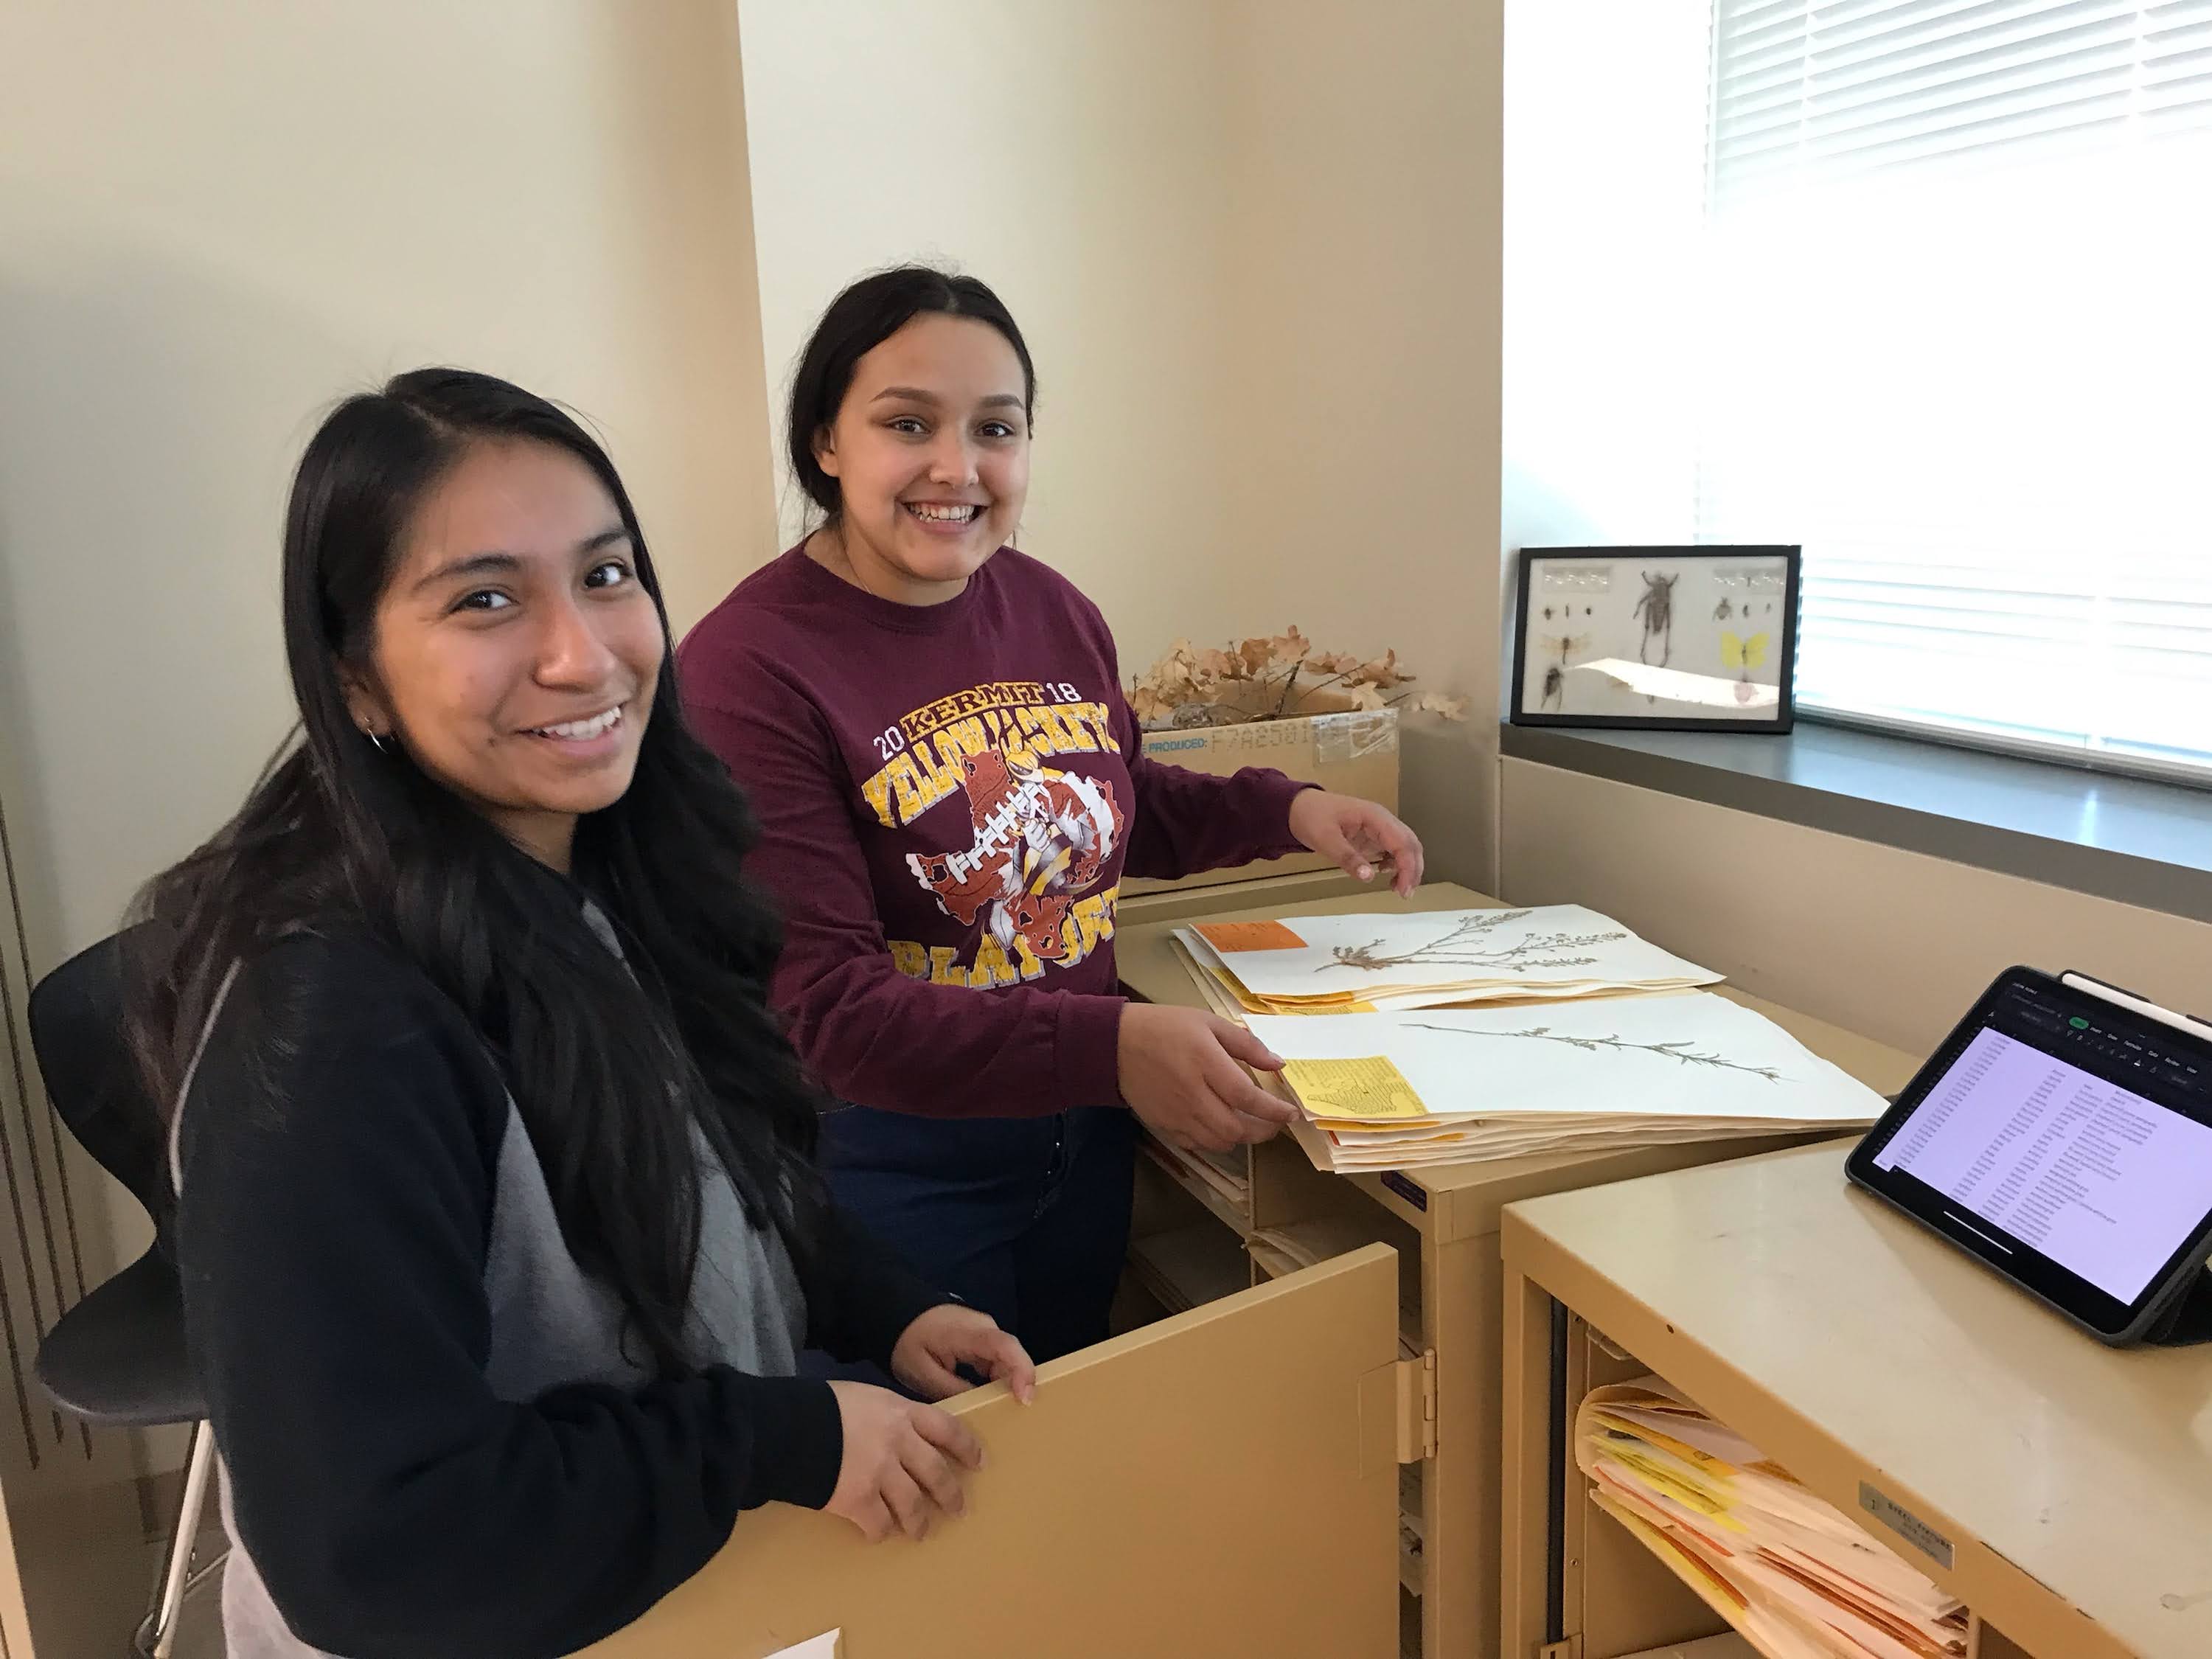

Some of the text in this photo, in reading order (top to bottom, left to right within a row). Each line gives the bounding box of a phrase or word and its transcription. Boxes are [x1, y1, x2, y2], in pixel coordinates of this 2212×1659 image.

[873, 681, 1082, 762] 20 KERMIT 18
[1148, 737, 1208, 753] PRODUCED:
[861, 715, 990, 830] YELLOW
